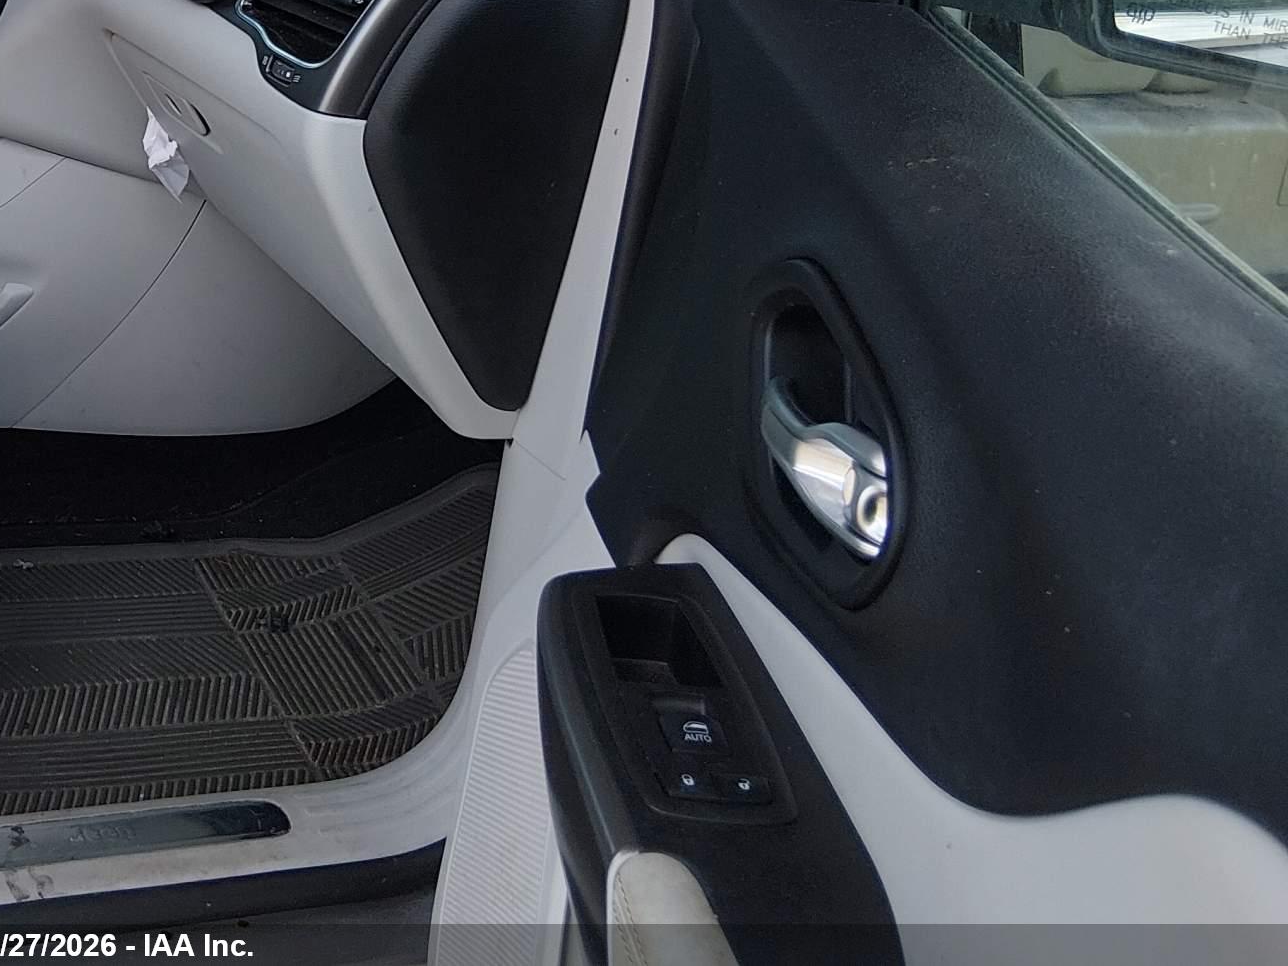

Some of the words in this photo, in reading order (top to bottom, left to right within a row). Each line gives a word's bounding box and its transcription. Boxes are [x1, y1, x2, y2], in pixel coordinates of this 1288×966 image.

[1239, 9, 1255, 24] IN
[1214, 20, 1251, 40] THAN
[685, 734, 711, 742] AUTO
